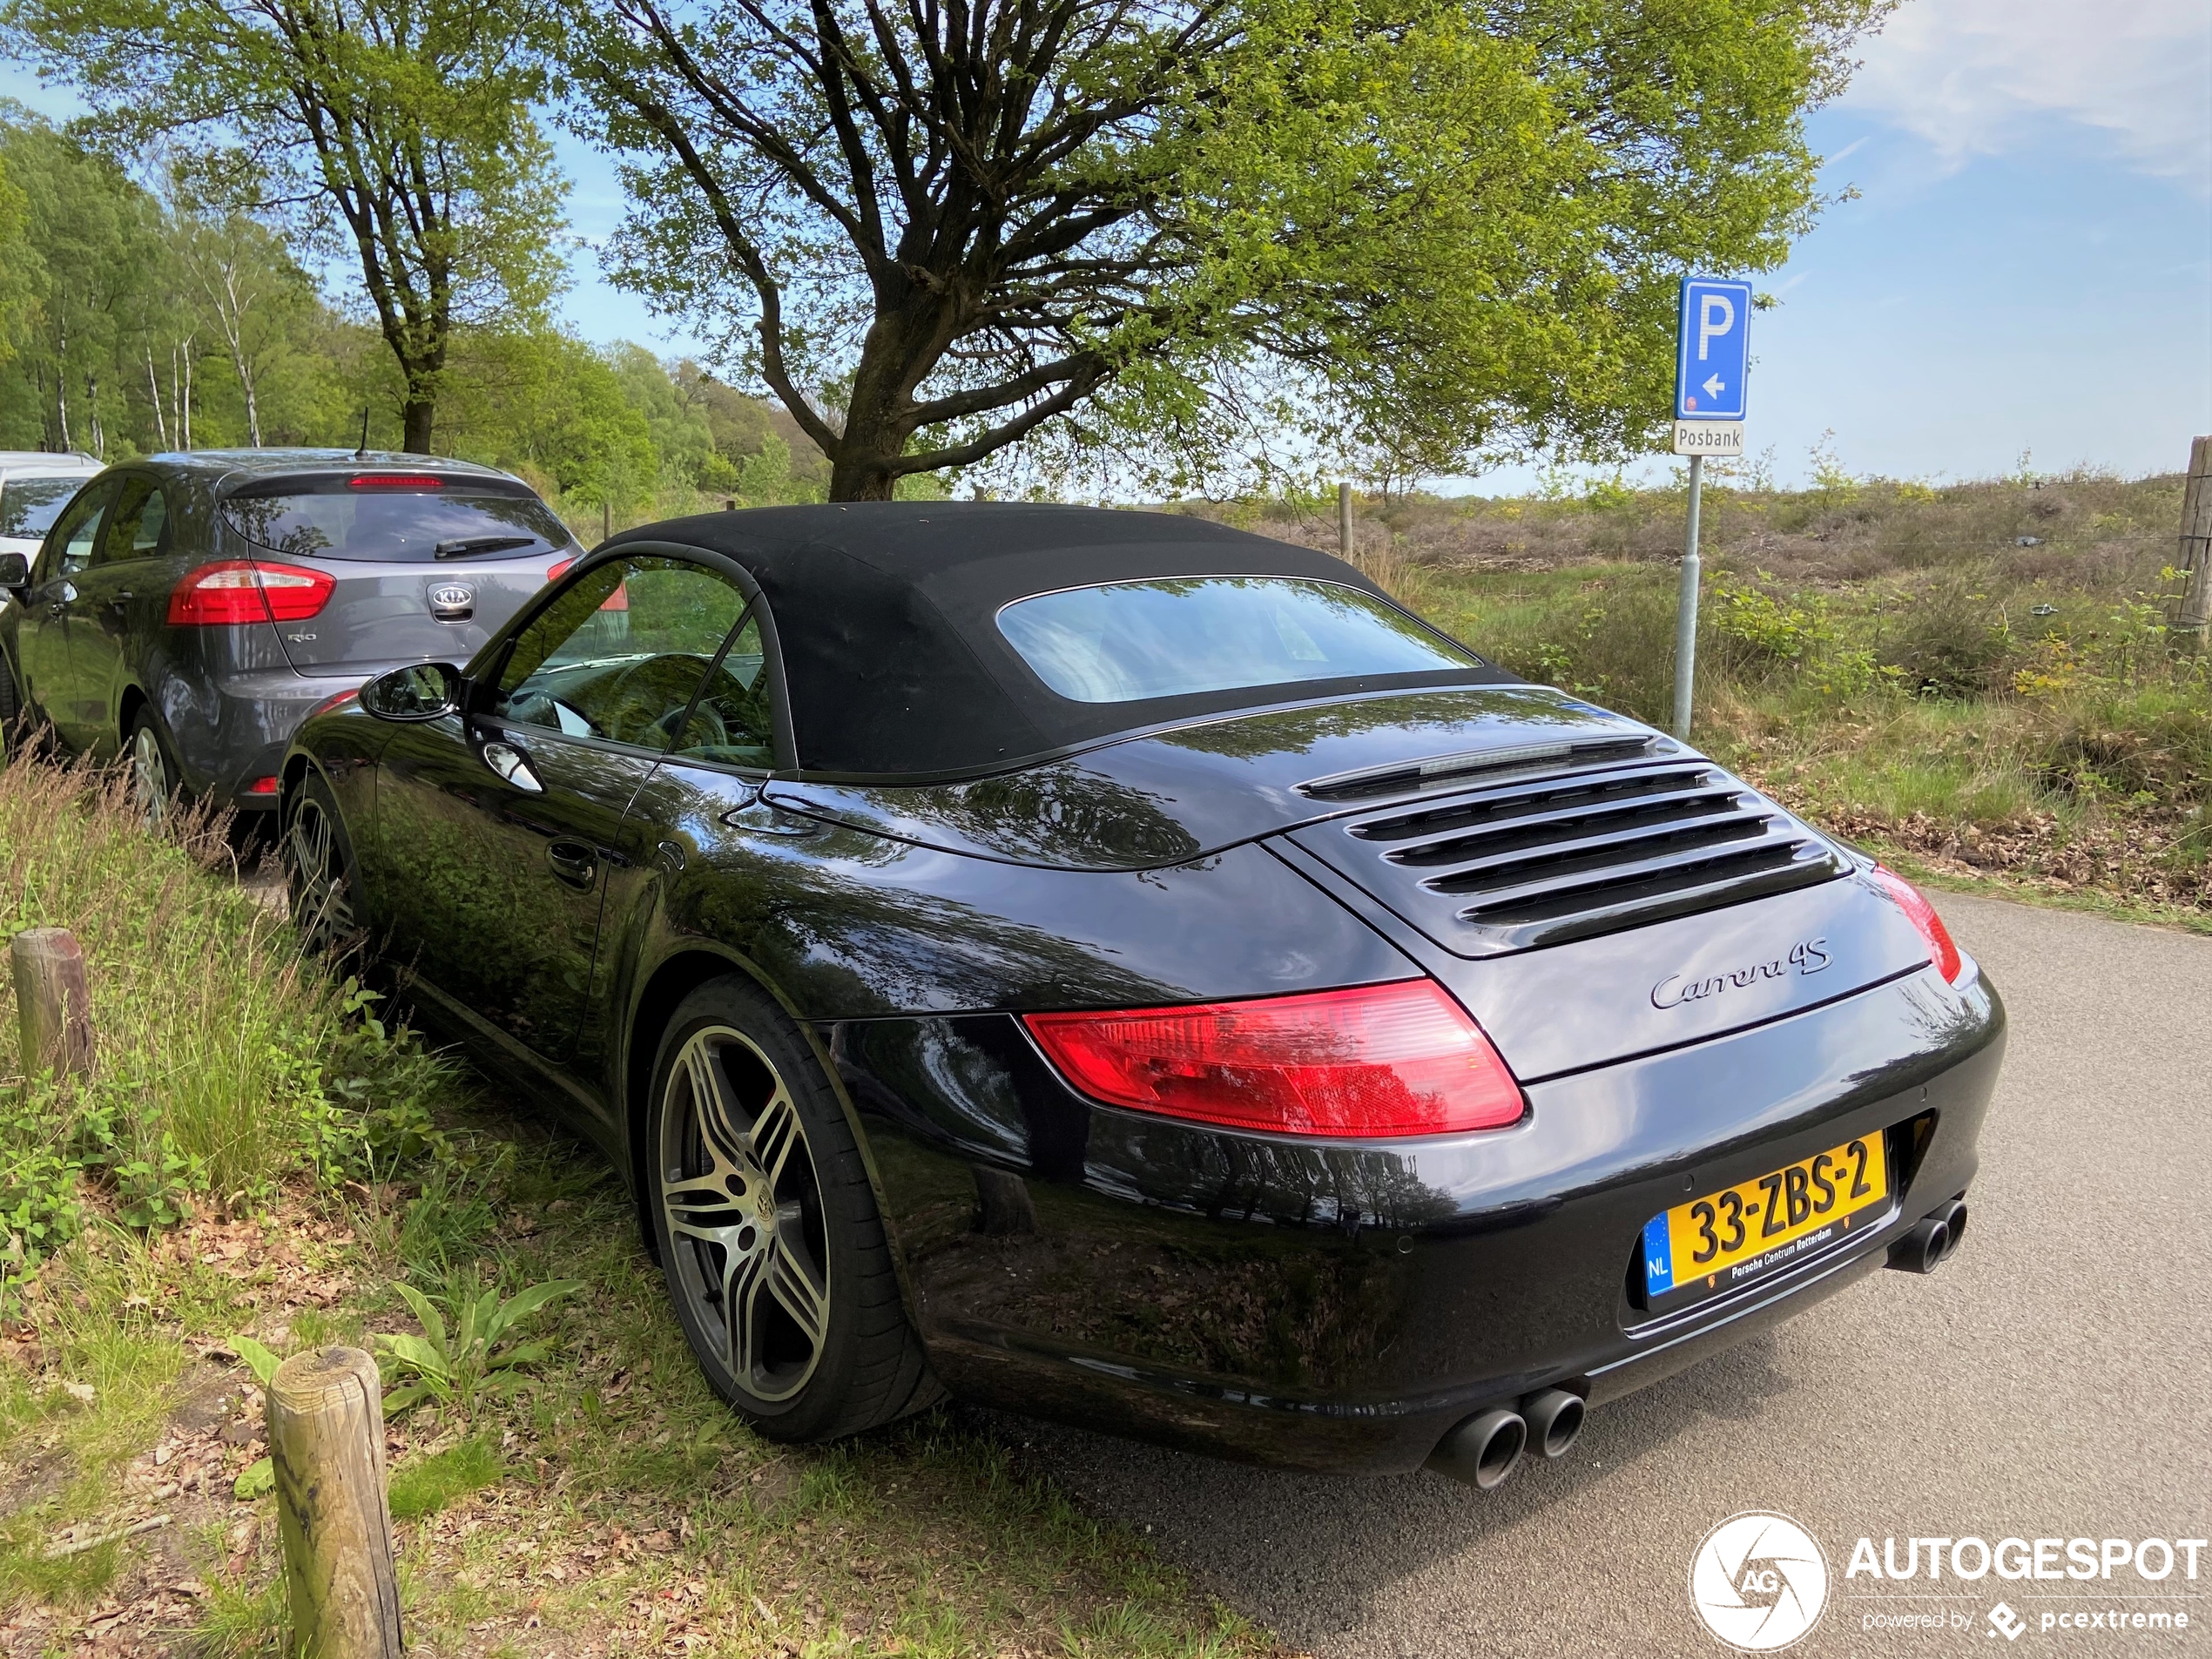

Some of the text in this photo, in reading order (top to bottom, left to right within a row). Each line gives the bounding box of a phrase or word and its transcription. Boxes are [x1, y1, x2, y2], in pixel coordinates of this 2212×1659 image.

[1698, 294, 1735, 361] P
[1679, 428, 1740, 447] Posbank
[439, 591, 466, 603] KIA
[1650, 936, 1834, 1009] Carrera 4S
[1690, 1140, 1871, 1263] 33-ZBS-2
[1648, 1257, 1669, 1278] NL
[1731, 1228, 1831, 1279] Porsche Centrum Rotterdam
